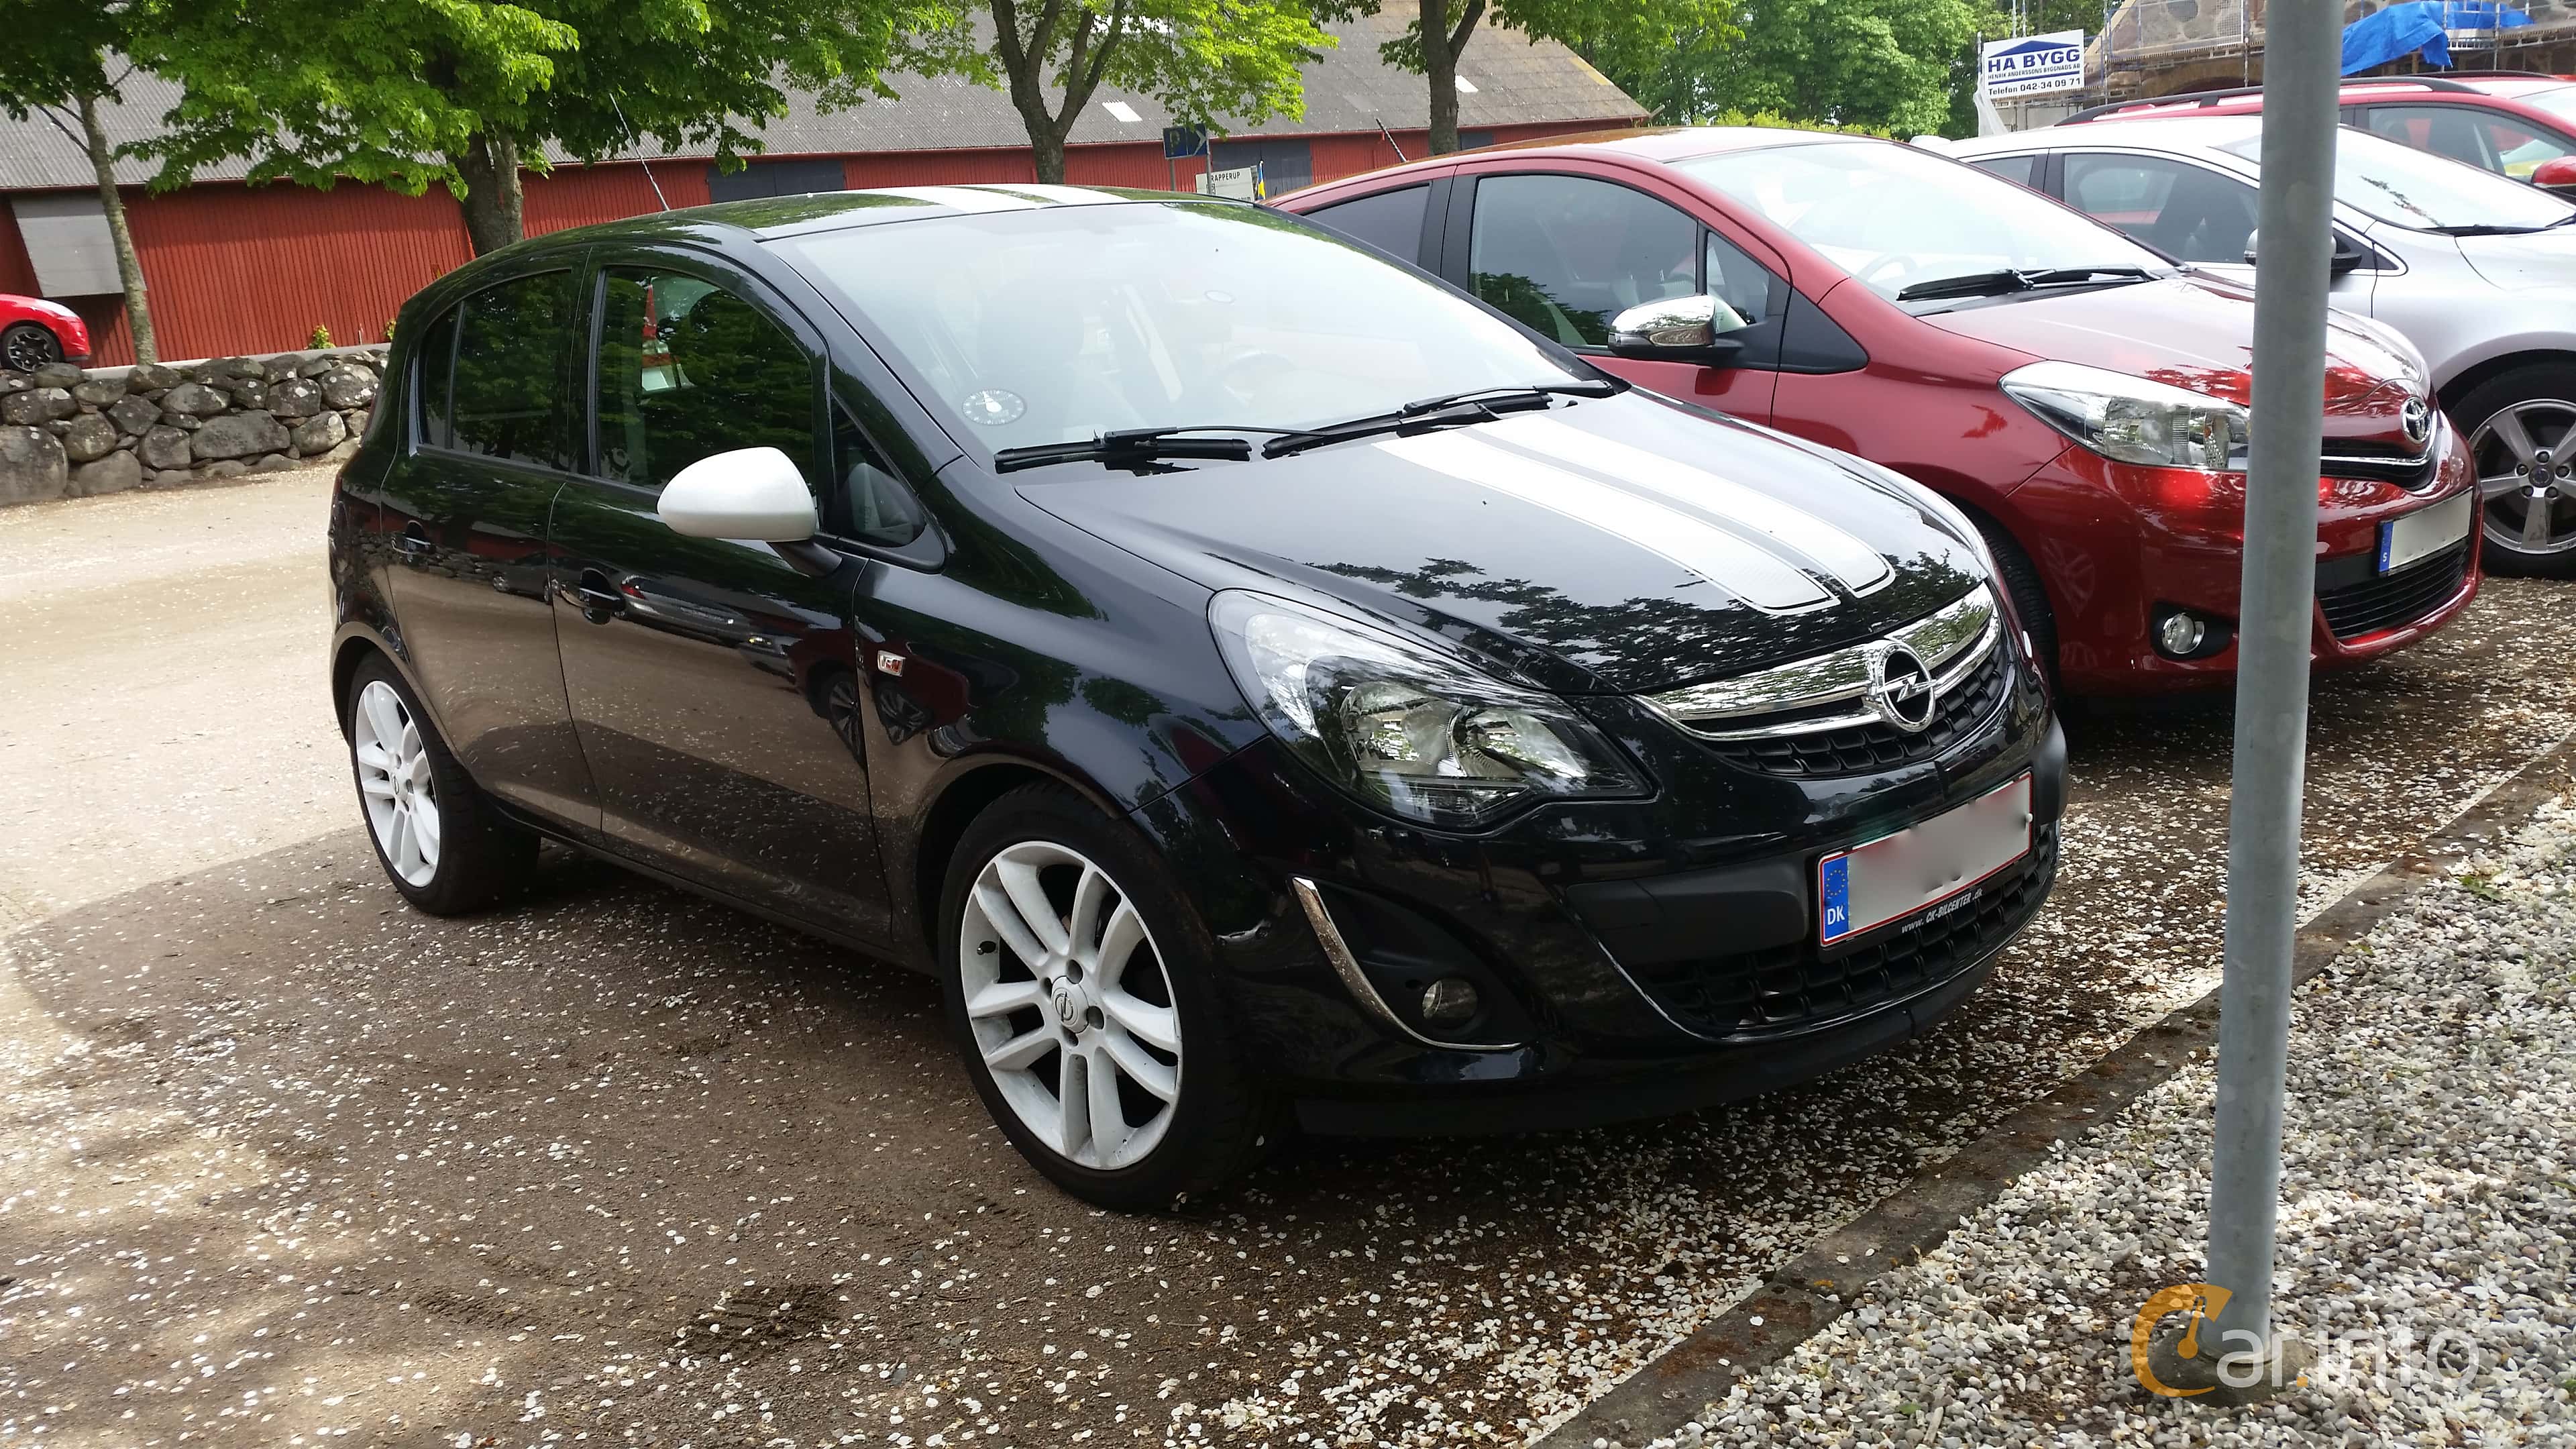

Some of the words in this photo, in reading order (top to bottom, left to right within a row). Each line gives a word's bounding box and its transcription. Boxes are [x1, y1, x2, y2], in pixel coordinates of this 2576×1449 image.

[1988, 58, 2017, 72] HA
[2023, 49, 2080, 68] BYGG
[2043, 64, 2072, 73] BYGGNADS
[1988, 86, 2018, 96] Telefon
[2020, 80, 2052, 92] 042-34
[2055, 79, 2066, 87] 09
[2069, 77, 2080, 86] 71
[1208, 172, 1240, 182] RAPPERUP
[2382, 551, 2387, 562] S
[1827, 905, 1845, 926] DK
